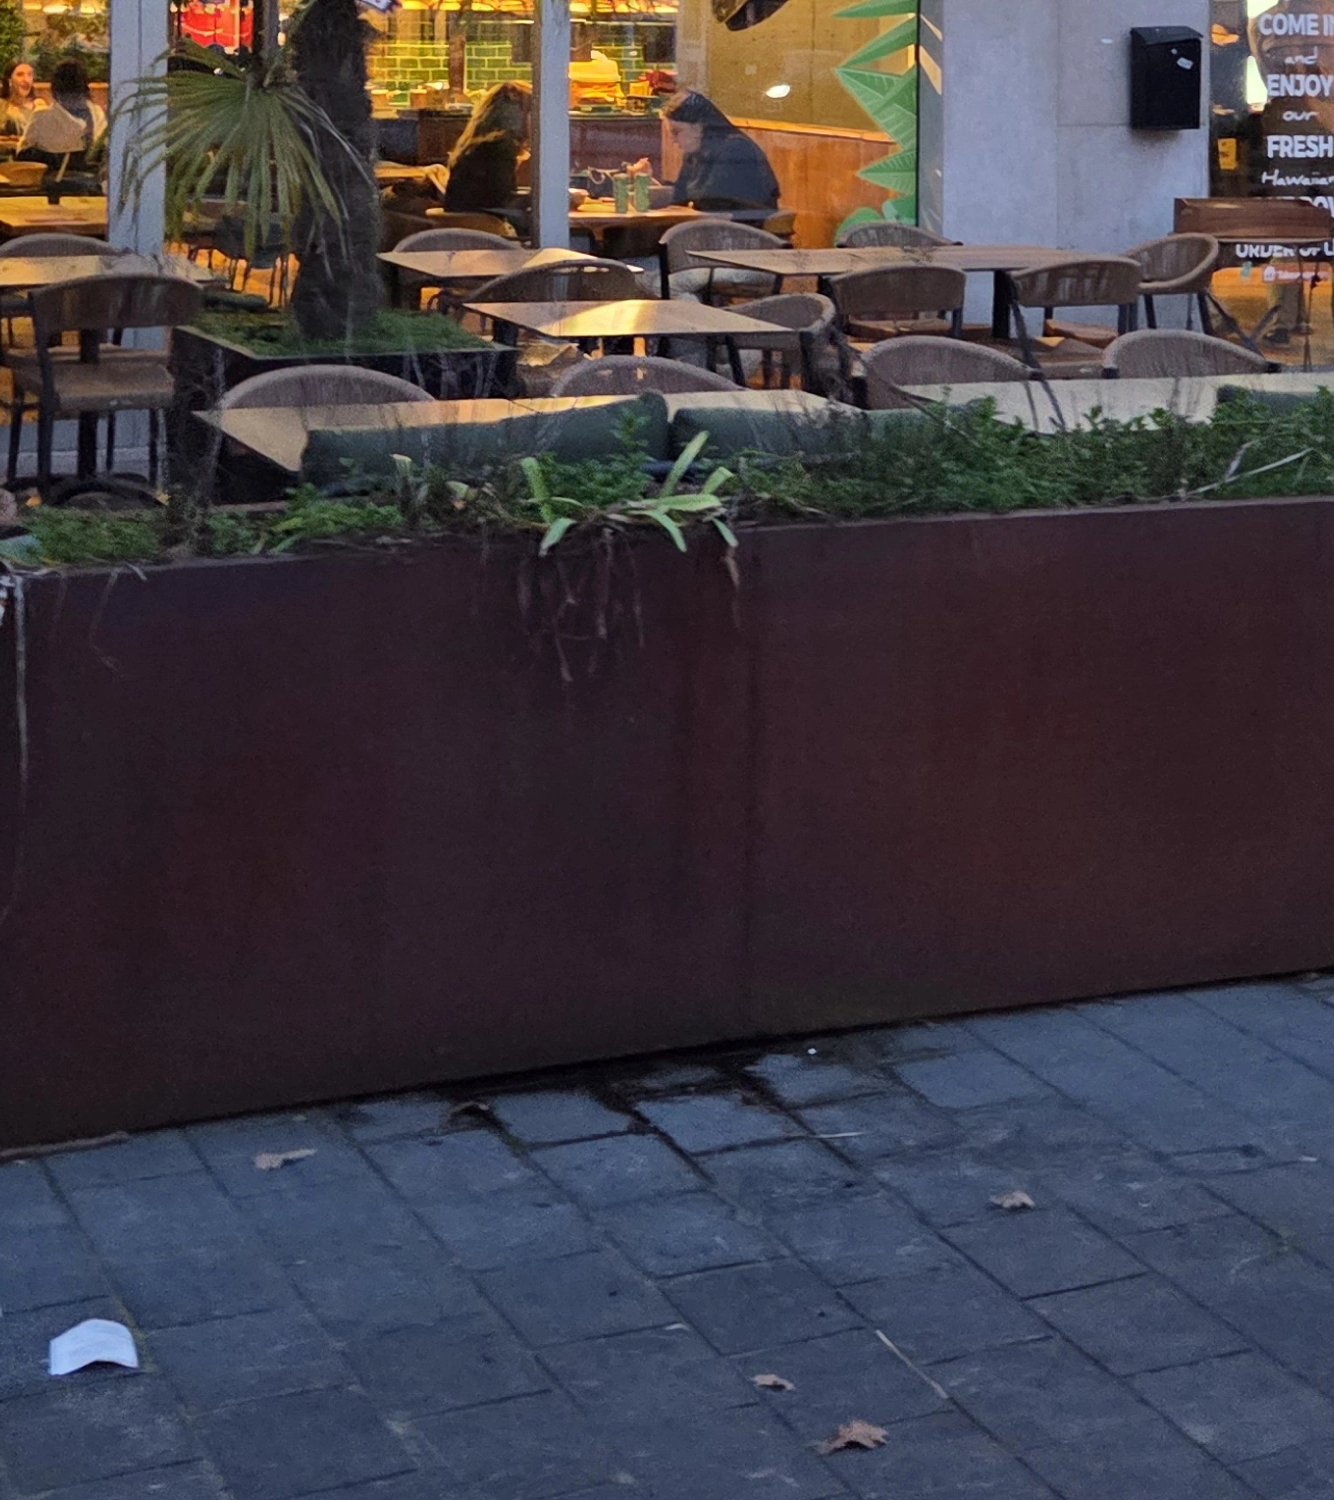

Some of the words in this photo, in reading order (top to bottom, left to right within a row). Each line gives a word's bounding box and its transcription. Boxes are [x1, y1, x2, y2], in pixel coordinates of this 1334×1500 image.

[1258, 13, 1320, 36] COME
[1284, 45, 1319, 65] and
[1267, 74, 1334, 97] ENJOY
[1282, 110, 1319, 121] our
[1266, 134, 1334, 158] FRESH
